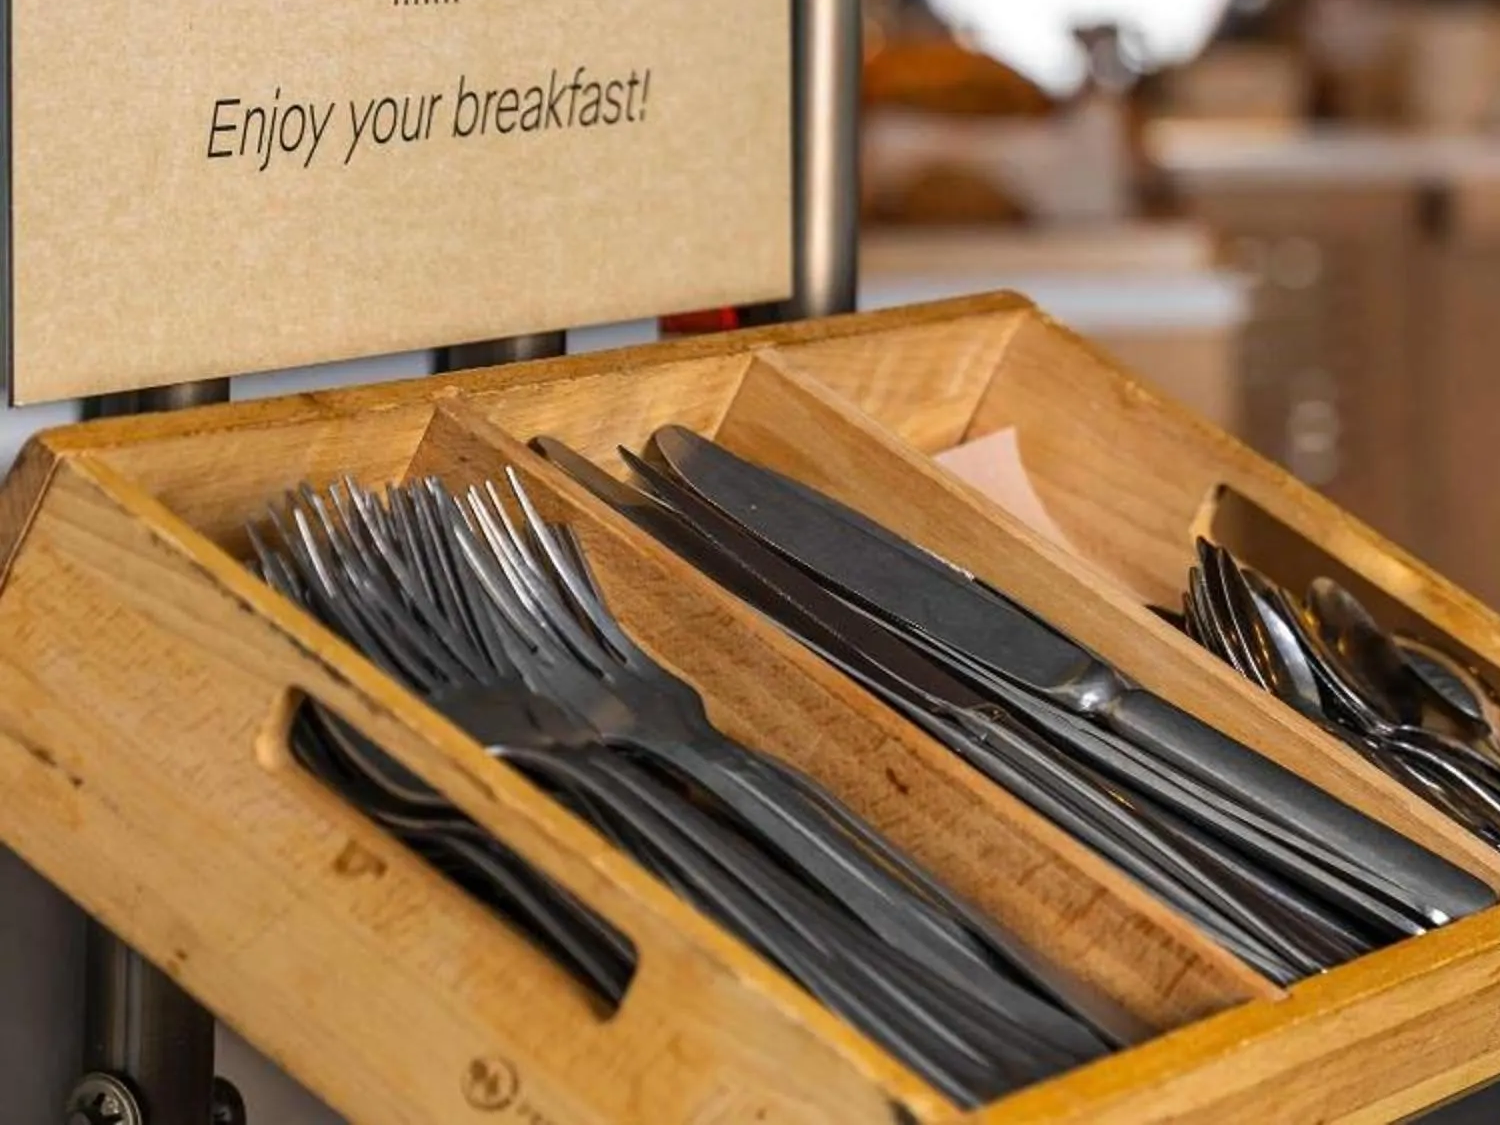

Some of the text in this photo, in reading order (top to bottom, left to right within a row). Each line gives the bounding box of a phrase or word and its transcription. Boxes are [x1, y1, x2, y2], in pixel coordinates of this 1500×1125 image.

[206, 66, 652, 172] Enjoy your breakfast!
